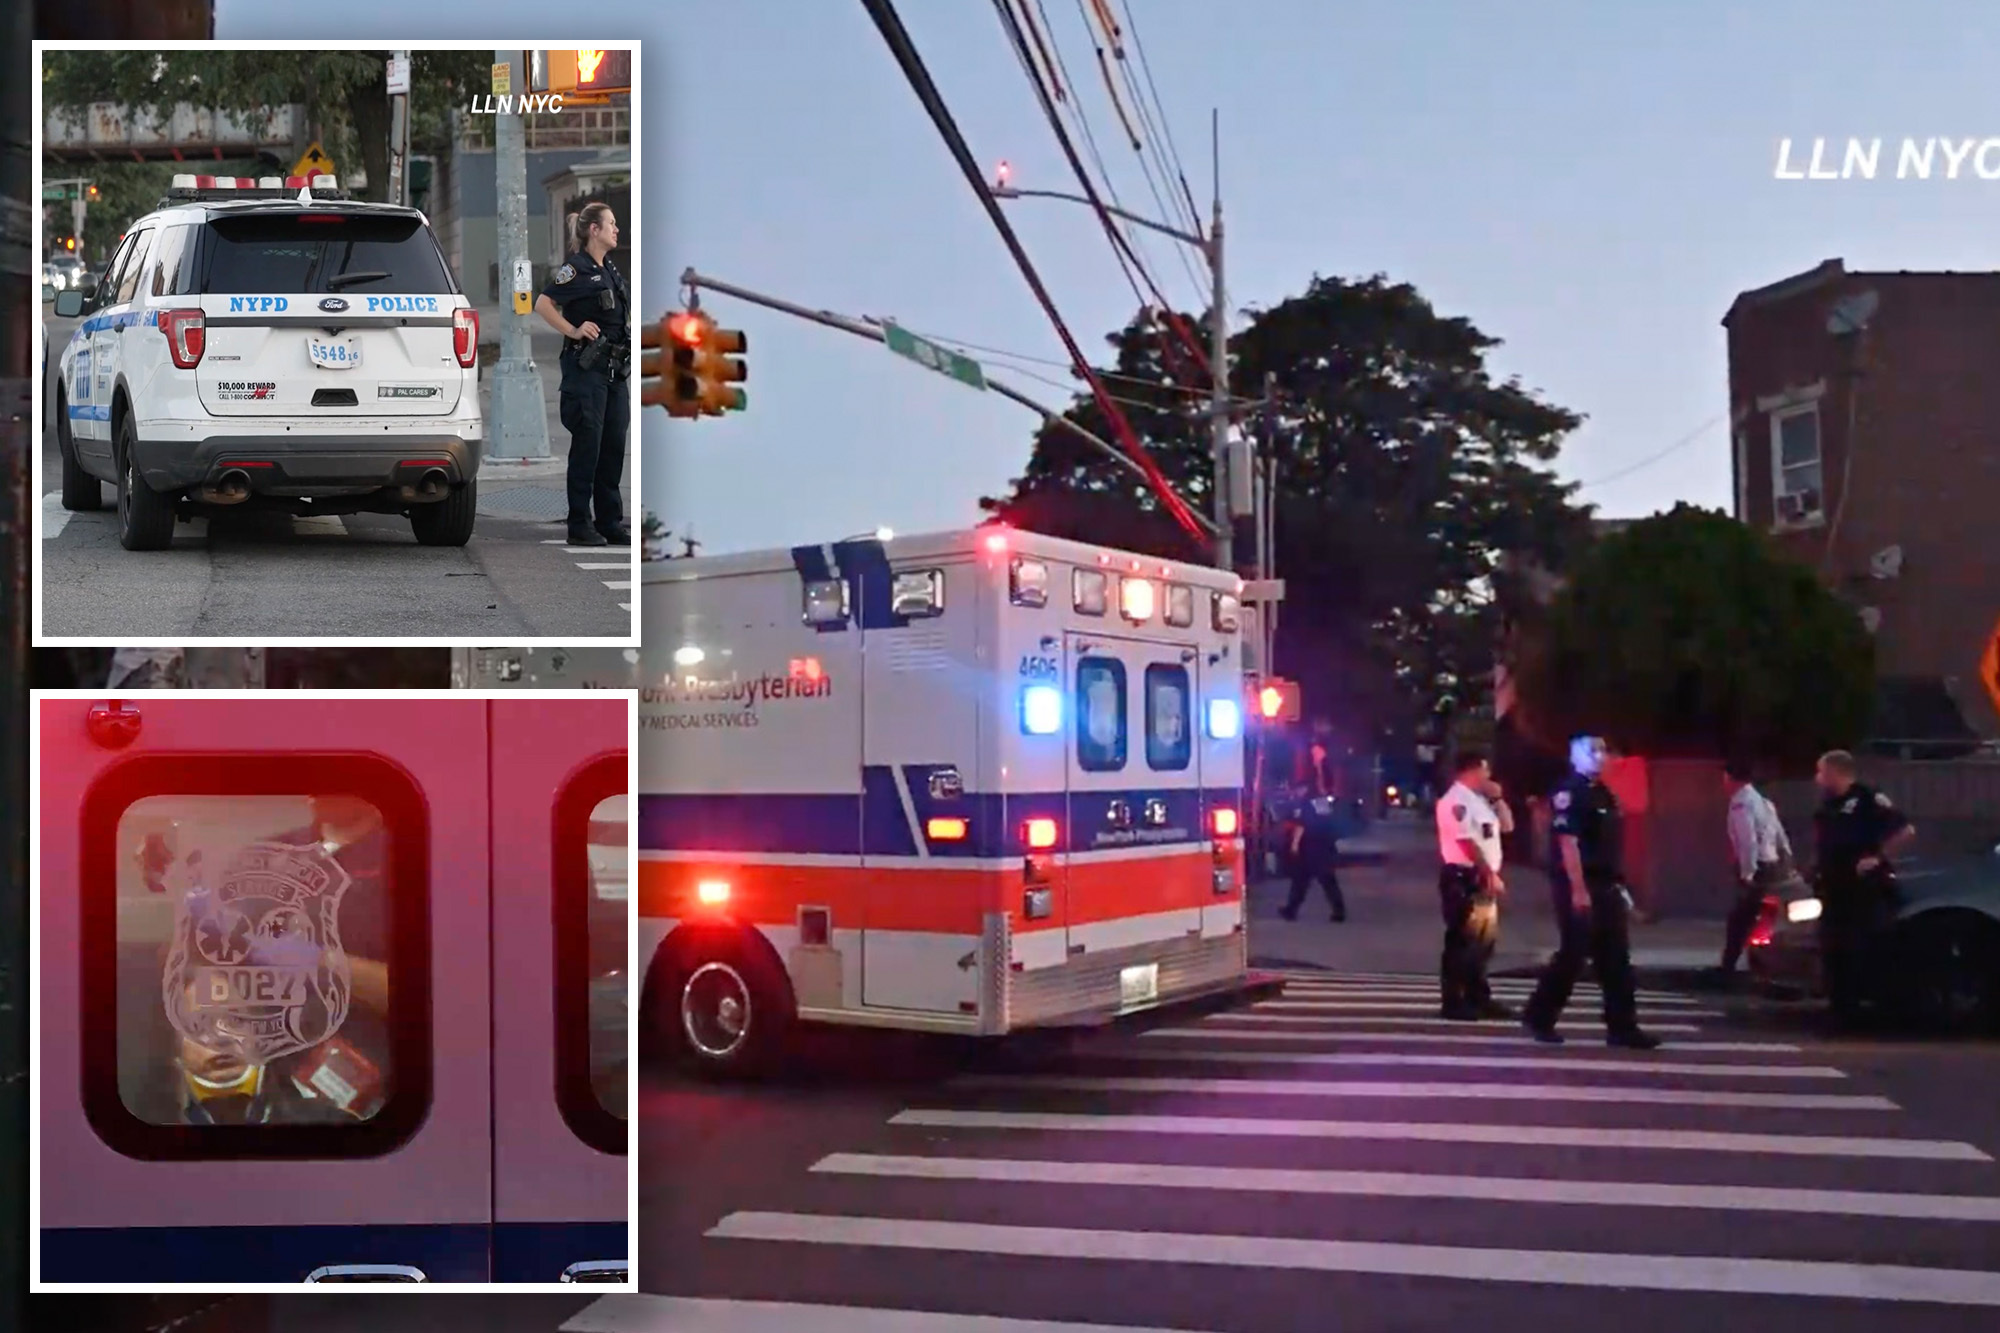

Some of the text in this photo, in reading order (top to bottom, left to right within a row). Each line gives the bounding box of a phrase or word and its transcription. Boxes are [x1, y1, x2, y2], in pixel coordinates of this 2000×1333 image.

[230, 297, 288, 312] NYPD
[325, 300, 343, 309] Ford
[367, 297, 438, 312] POLICE
[312, 344, 359, 361] 5548 16
[218, 382, 276, 391] $10,000 REWARD
[397, 388, 429, 396] PAL CARES
